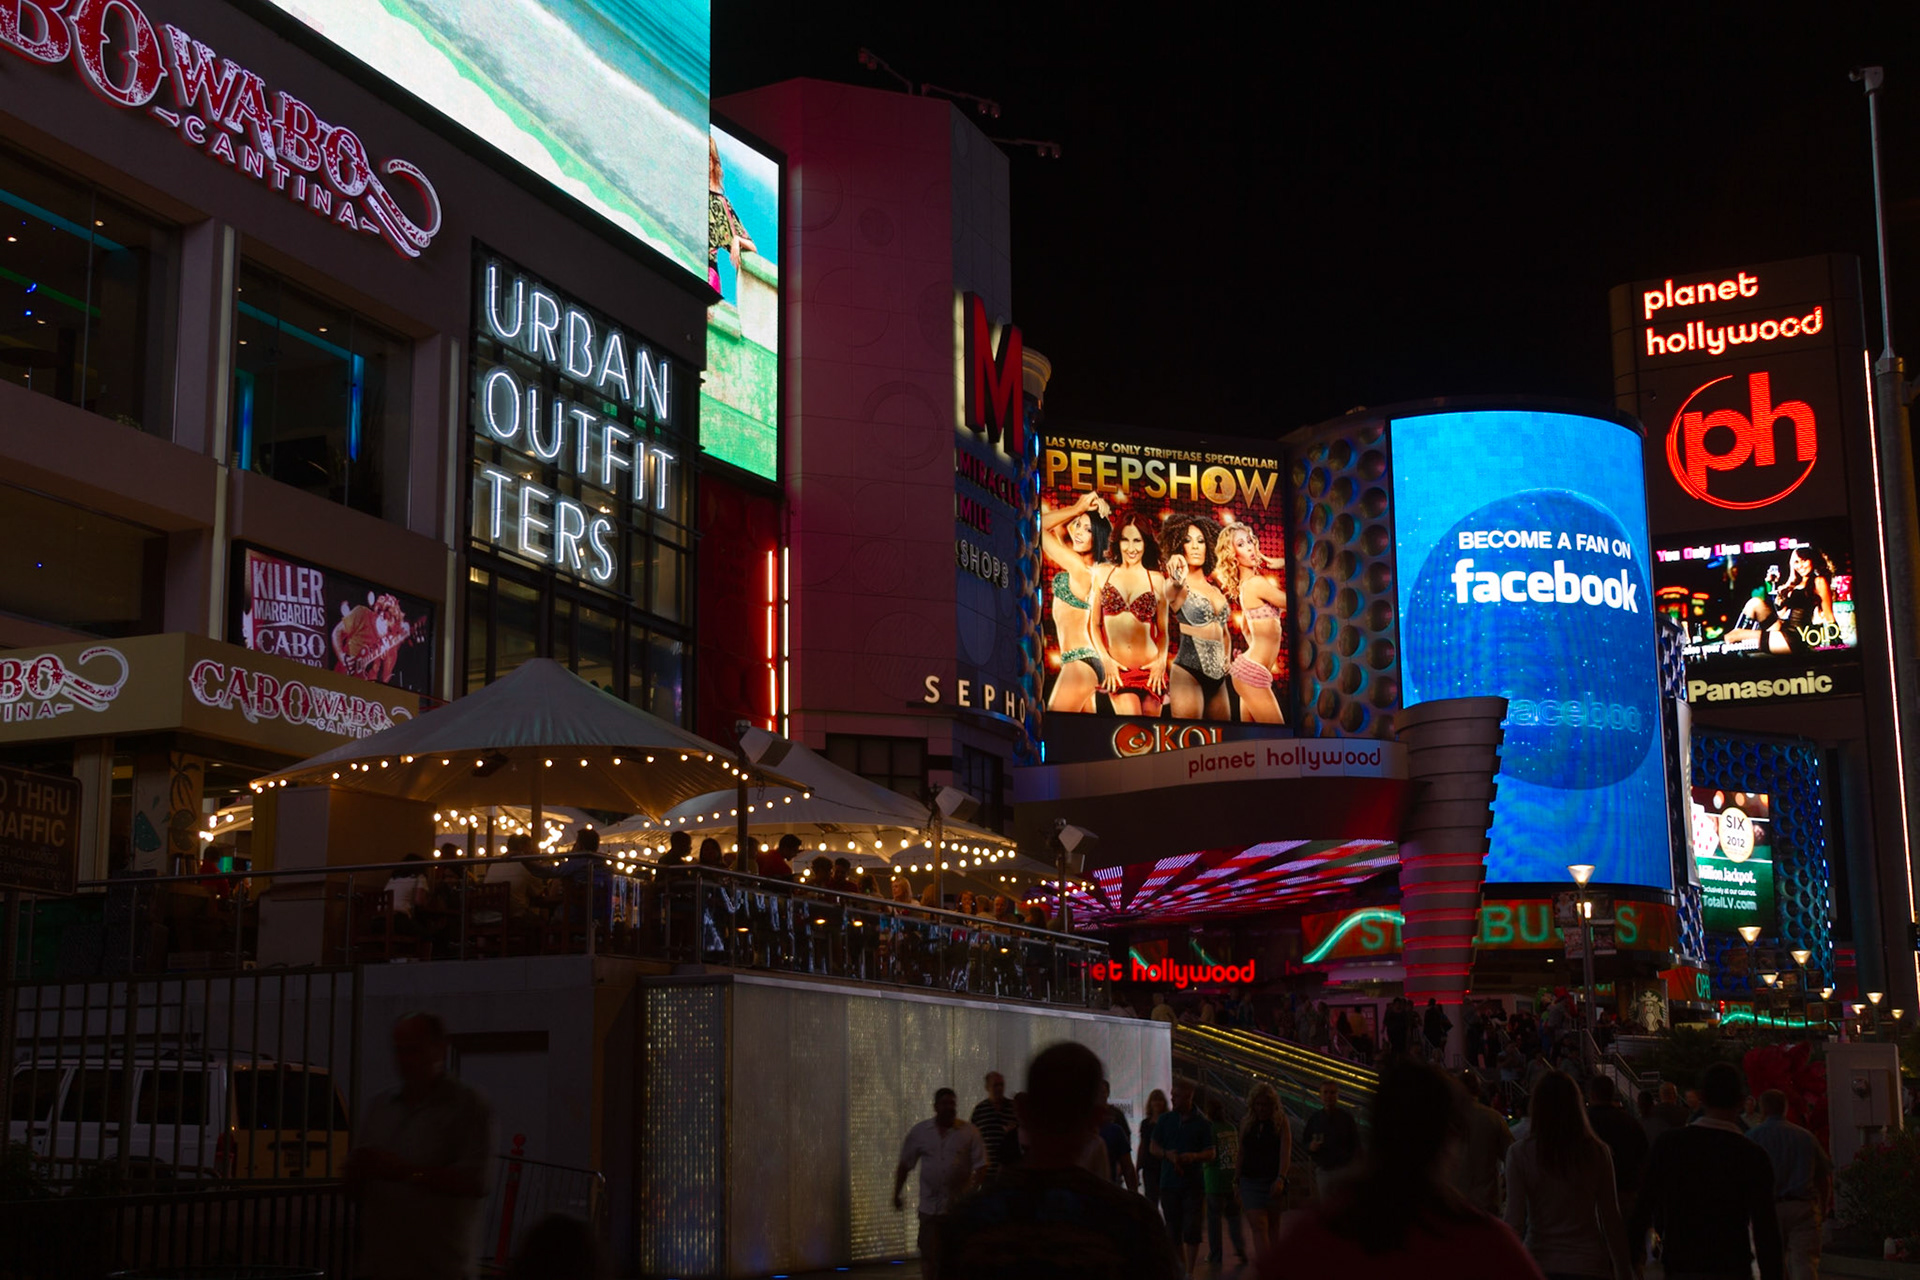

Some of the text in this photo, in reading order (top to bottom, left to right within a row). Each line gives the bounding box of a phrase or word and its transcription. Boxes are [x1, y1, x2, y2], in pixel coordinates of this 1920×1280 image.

[165, 24, 369, 197] WABO
[184, 115, 359, 231] CANTINA
[1644, 272, 1758, 320] planet
[485, 264, 670, 420] URBAN
[1647, 306, 1822, 355] hollywood
[964, 292, 1024, 460] M
[485, 371, 675, 511] OUTFIT
[1045, 436, 1278, 470] LAS VEGAS' ONLY STRIPTEASE SPECTACULAR!
[1683, 371, 1817, 493] ph
[959, 448, 1021, 508] MIRACLE
[1045, 449, 1279, 511] PEEPSHOW
[485, 468, 616, 581] TERS
[959, 494, 993, 534] MILE
[960, 539, 1009, 589] SHOPS
[1458, 529, 1632, 560] BECOME A FAN ON
[252, 560, 325, 606] KILLER
[1450, 558, 1639, 614] facebook
[253, 598, 326, 627] MARGARITAS
[256, 628, 326, 659] CABO
[189, 659, 388, 732] CABO WABO
[1688, 671, 1832, 702] Panasonic
[1188, 747, 1381, 778] planet hollywood
[14, 779, 71, 815] THRU
[1726, 814, 1745, 831] SIX
[1726, 835, 1745, 848] 2012
[1701, 895, 1757, 910] TotalLV.com
[1131, 957, 1256, 989] hollywood
